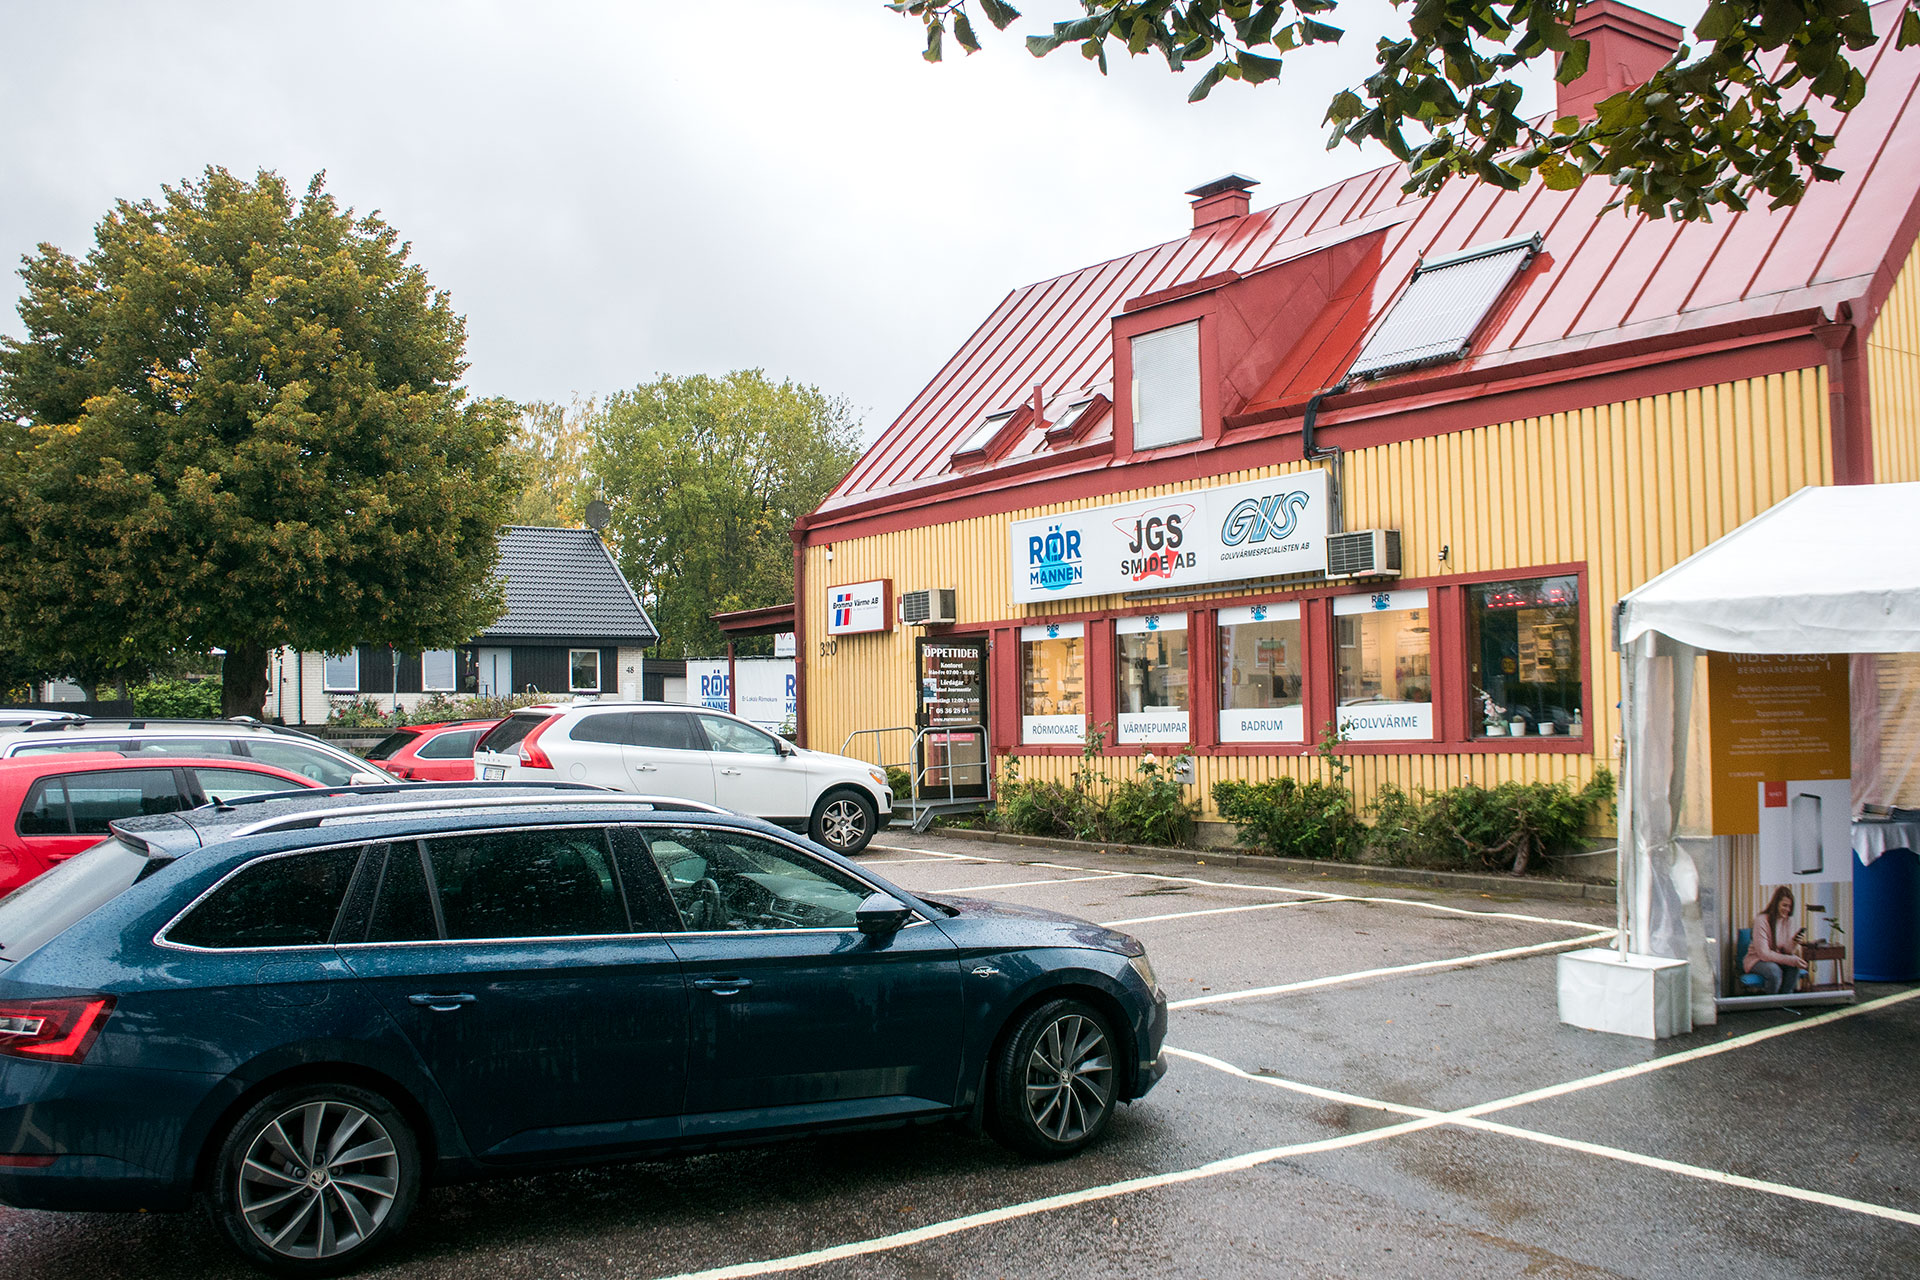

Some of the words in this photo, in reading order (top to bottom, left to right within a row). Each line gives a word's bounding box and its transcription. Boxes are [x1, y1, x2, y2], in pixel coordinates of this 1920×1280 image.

[1221, 490, 1310, 547] GVS
[1129, 514, 1183, 554] JGS
[1029, 525, 1082, 565] RÖR
[1220, 542, 1299, 561] GOLVVÄRMESPECIALISTEN
[1300, 542, 1310, 551] AB
[1121, 554, 1168, 576] SMIDE
[1175, 552, 1196, 569] AB
[1030, 566, 1083, 585] MANNEN
[833, 601, 853, 609] Bromma
[854, 598, 870, 606] Värme
[871, 596, 879, 604] AB
[1372, 592, 1390, 604] RÖR
[1251, 605, 1267, 614] RÖR
[1145, 615, 1159, 624] RÖR
[820, 640, 837, 657] 320
[924, 645, 978, 658] ÖPPETTIDER
[626, 666, 635, 674] 48
[1032, 722, 1078, 735] RÖRMOKARE
[1123, 721, 1187, 734] VÄRMEPUMPAR
[1241, 720, 1283, 731] BADRUM
[1352, 714, 1418, 730] GOLVVÄRME
